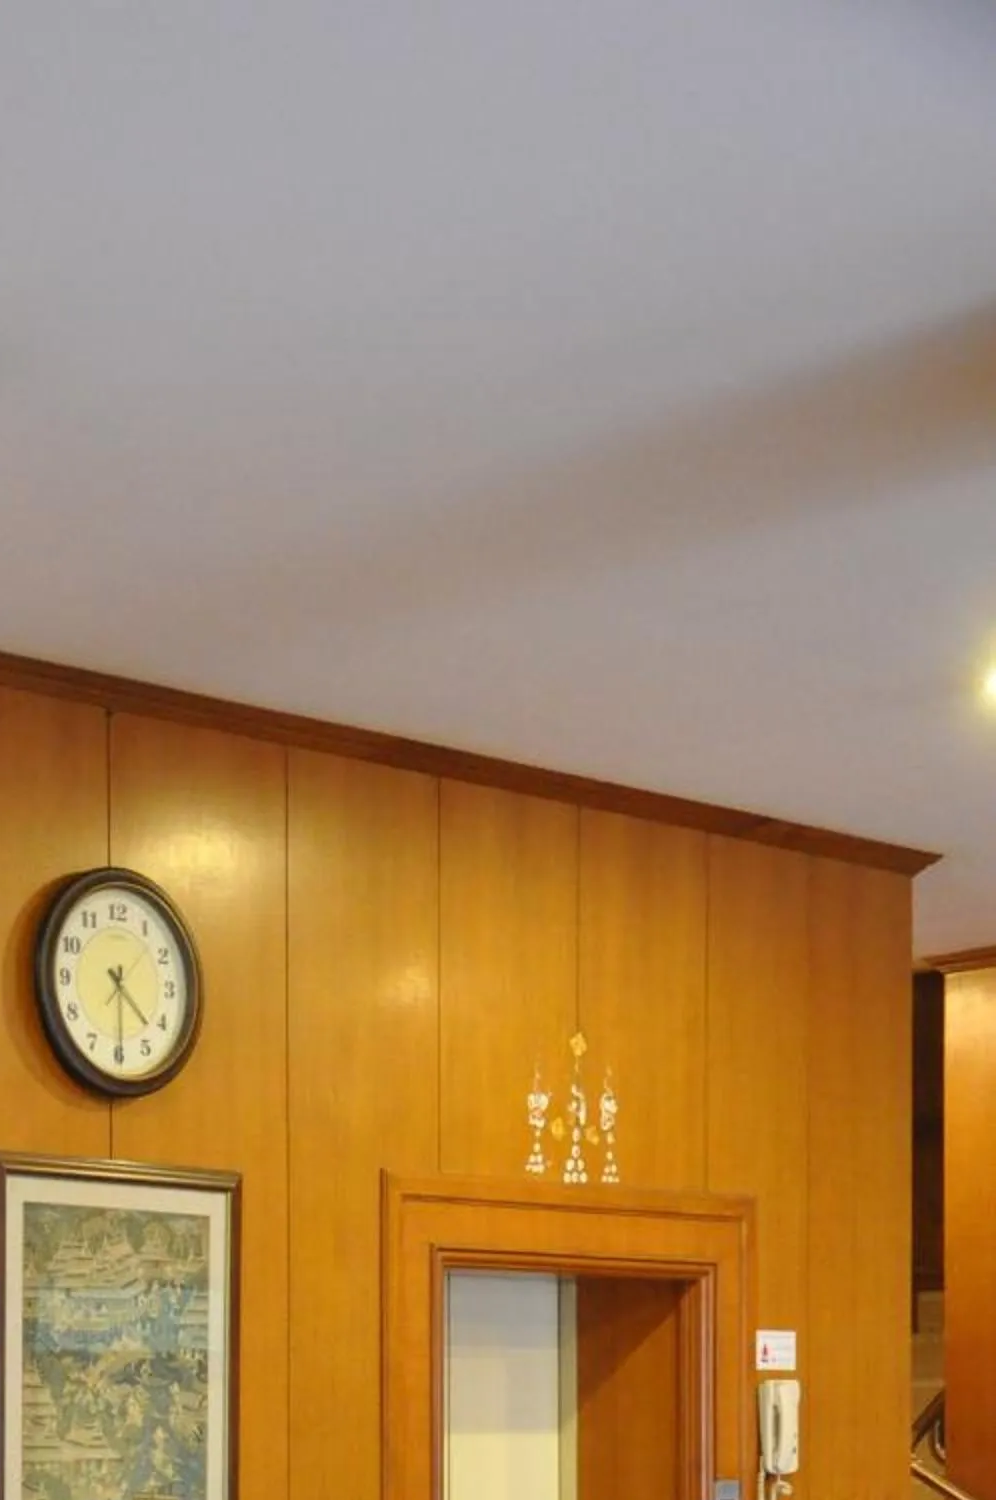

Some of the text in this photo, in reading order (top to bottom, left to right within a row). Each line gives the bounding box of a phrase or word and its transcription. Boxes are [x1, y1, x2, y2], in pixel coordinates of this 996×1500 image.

[81, 911, 97, 929] 11
[108, 903, 128, 922] 12
[141, 920, 148, 937] 1
[62, 935, 81, 953] 10
[157, 948, 169, 965] 2
[59, 967, 71, 985] 9
[164, 980, 175, 999] 3
[66, 1003, 79, 1021] 8
[157, 1013, 167, 1031] 4
[86, 1032, 98, 1050] 7
[140, 1039, 151, 1057] 5
[113, 1045, 125, 1064] 6
